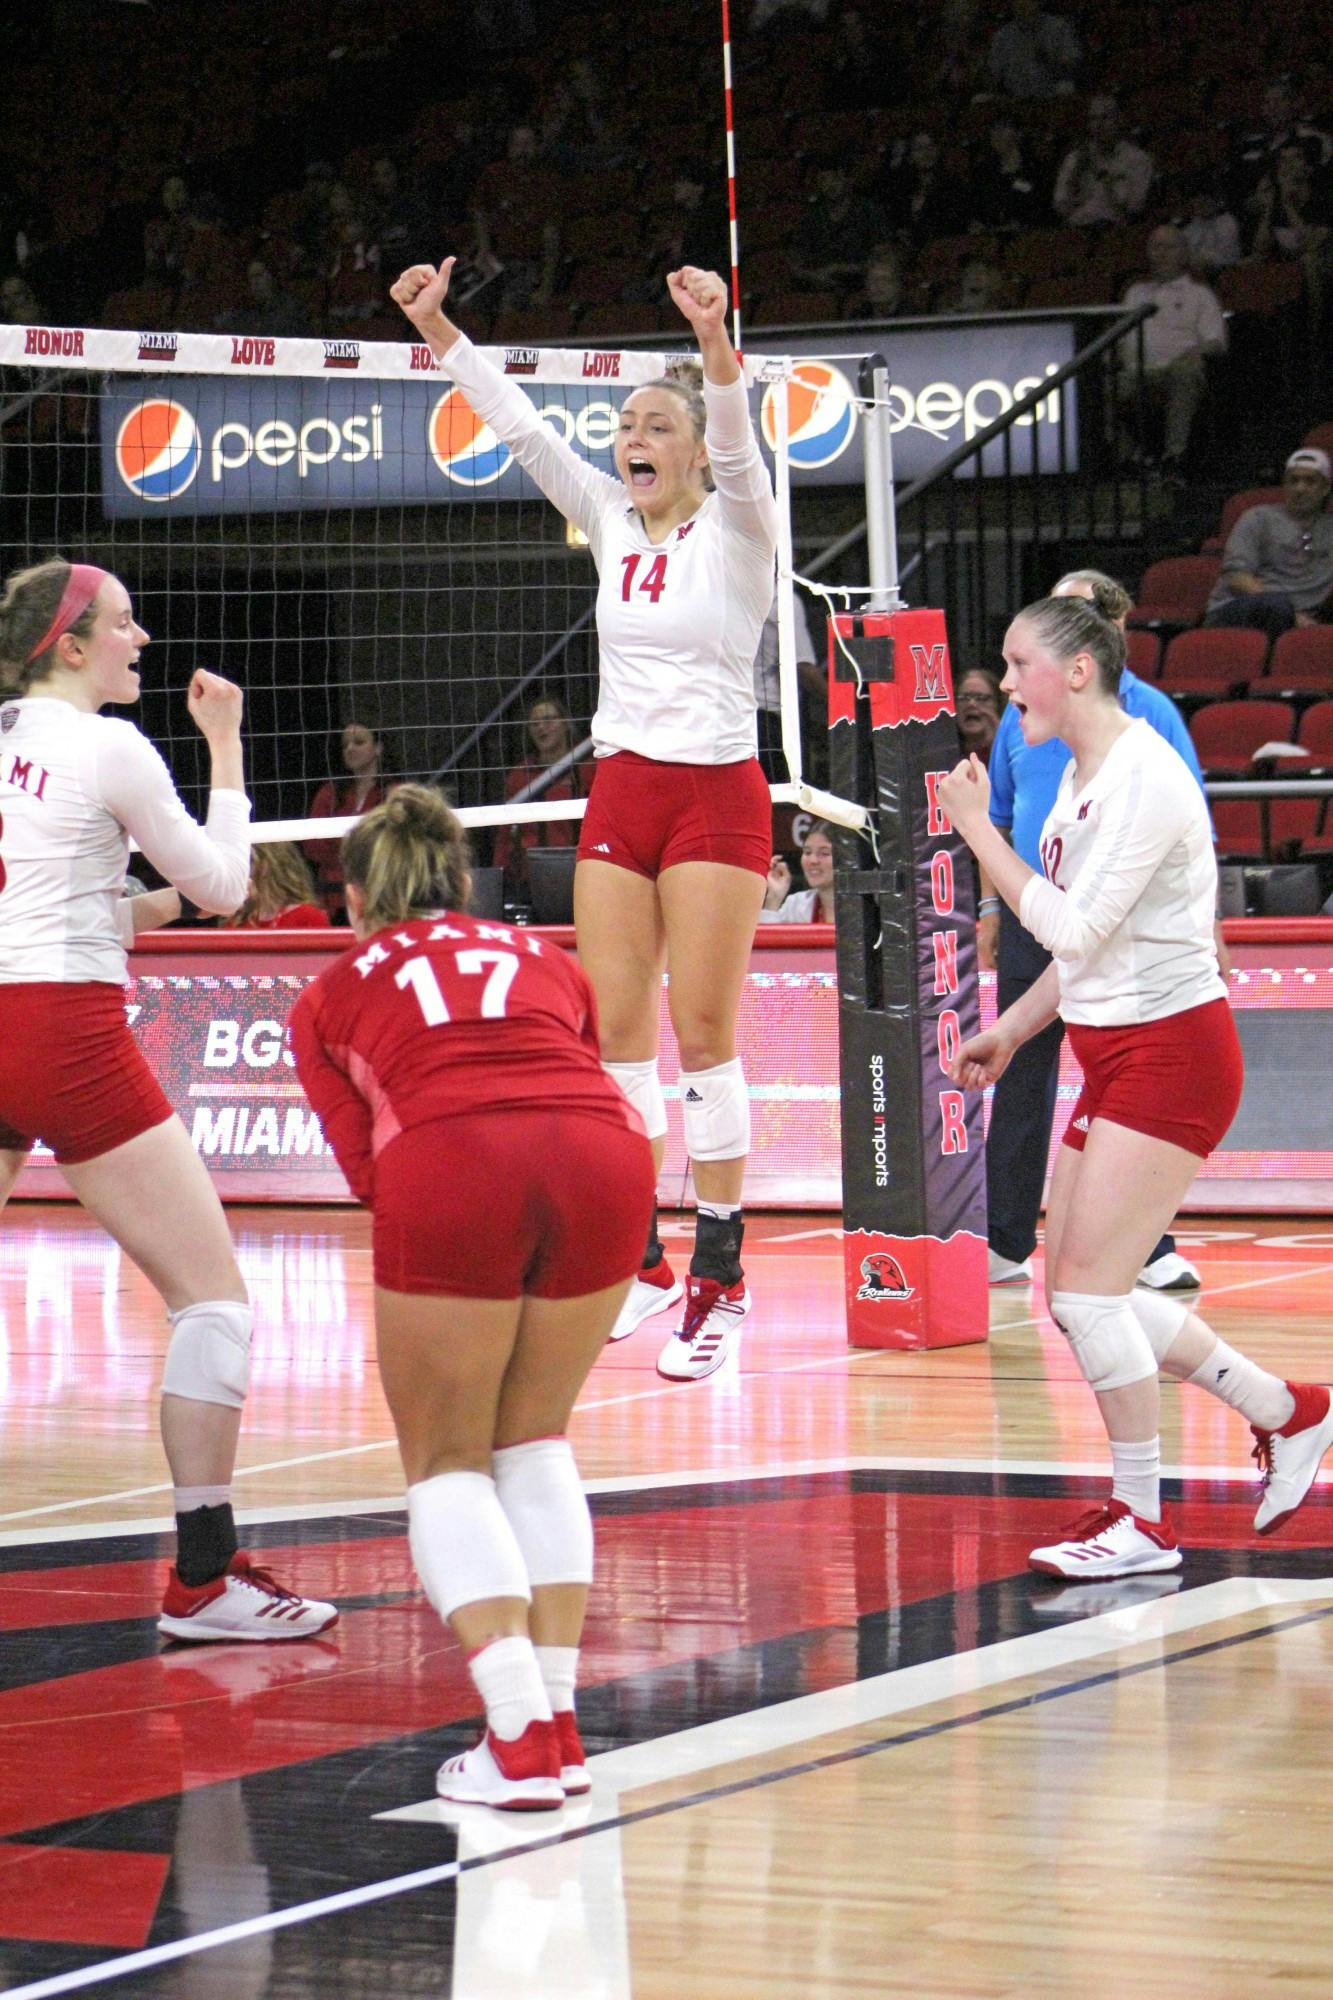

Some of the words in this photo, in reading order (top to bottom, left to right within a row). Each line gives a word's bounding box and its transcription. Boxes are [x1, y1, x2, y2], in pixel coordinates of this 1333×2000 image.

[24, 328, 84, 357] HONOR
[138, 334, 178, 351] MIAMI
[231, 337, 275, 365] LOVE
[323, 342, 360, 359] MIAMI
[504, 349, 539, 365] MIAMI
[582, 352, 621, 377] LOVE
[212, 404, 383, 482] pepsi
[621, 553, 668, 603] 14
[909, 645, 950, 702] M
[0, 754, 50, 802] MI
[352, 924, 544, 980] MIAMI
[394, 948, 520, 1028] 17
[870, 1055, 885, 1113] sports
[191, 1106, 335, 1156] MIAM
